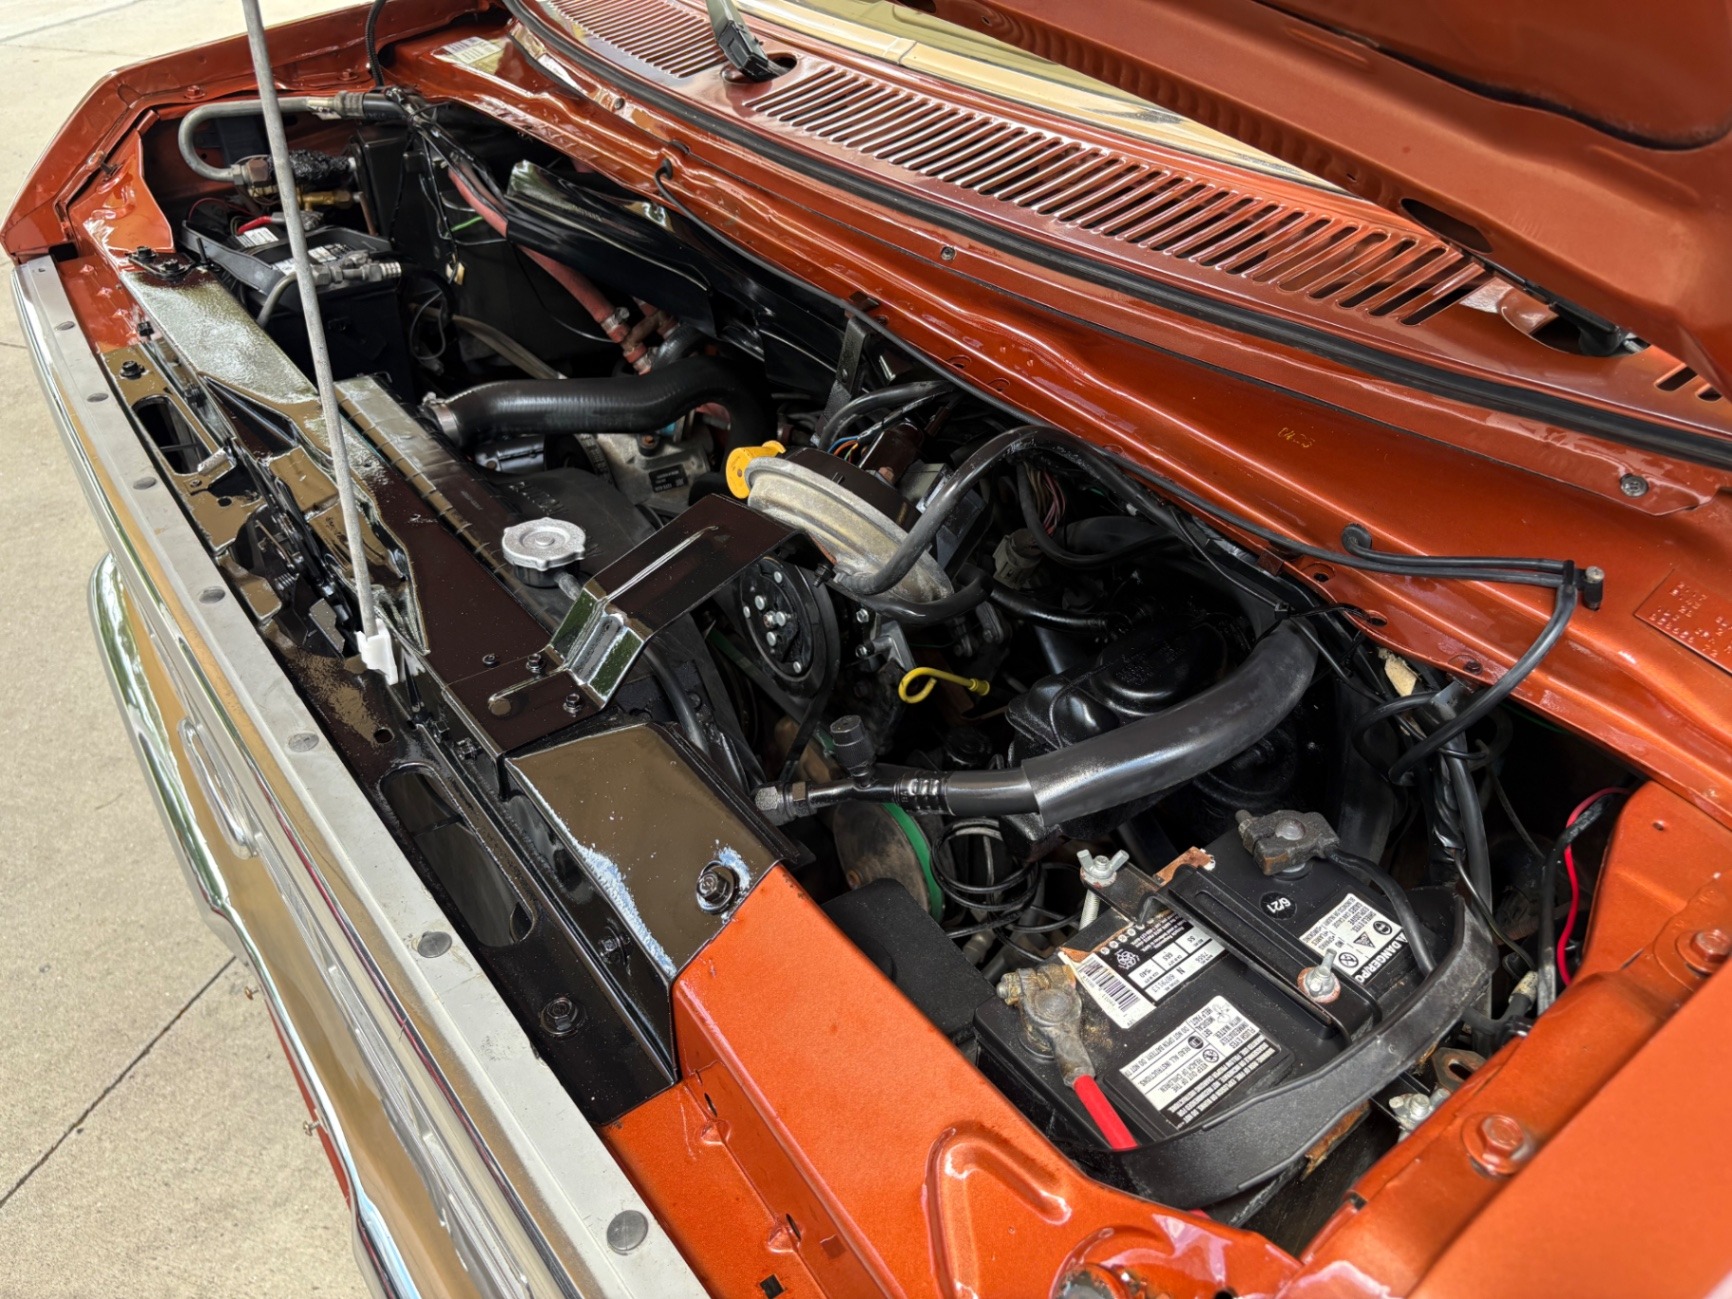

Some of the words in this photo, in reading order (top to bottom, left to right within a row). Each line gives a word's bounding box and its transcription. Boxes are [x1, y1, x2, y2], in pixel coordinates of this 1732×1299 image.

[1265, 893, 1292, 916] 6/21
[1180, 1025, 1189, 1033] DO
[1201, 1028, 1212, 1037] GET
[1238, 1026, 1256, 1040] FLUSH
[1172, 1030, 1183, 1040] NOT
[1161, 1036, 1175, 1048] OPEN
[1228, 1037, 1242, 1048] EYES
[1176, 1045, 1191, 1057] READ
[1137, 1058, 1147, 1066] DO
[1168, 1054, 1180, 1063] ALL
[1185, 1056, 1203, 1071] REACH
[1129, 1063, 1141, 1073] NOT
[1180, 1068, 1189, 1076] OF
[1194, 1061, 1208, 1073] KEEP
[1185, 1070, 1198, 1080] OUT
[1179, 1077, 1189, 1086] OF
[1170, 1082, 1182, 1092] THE
